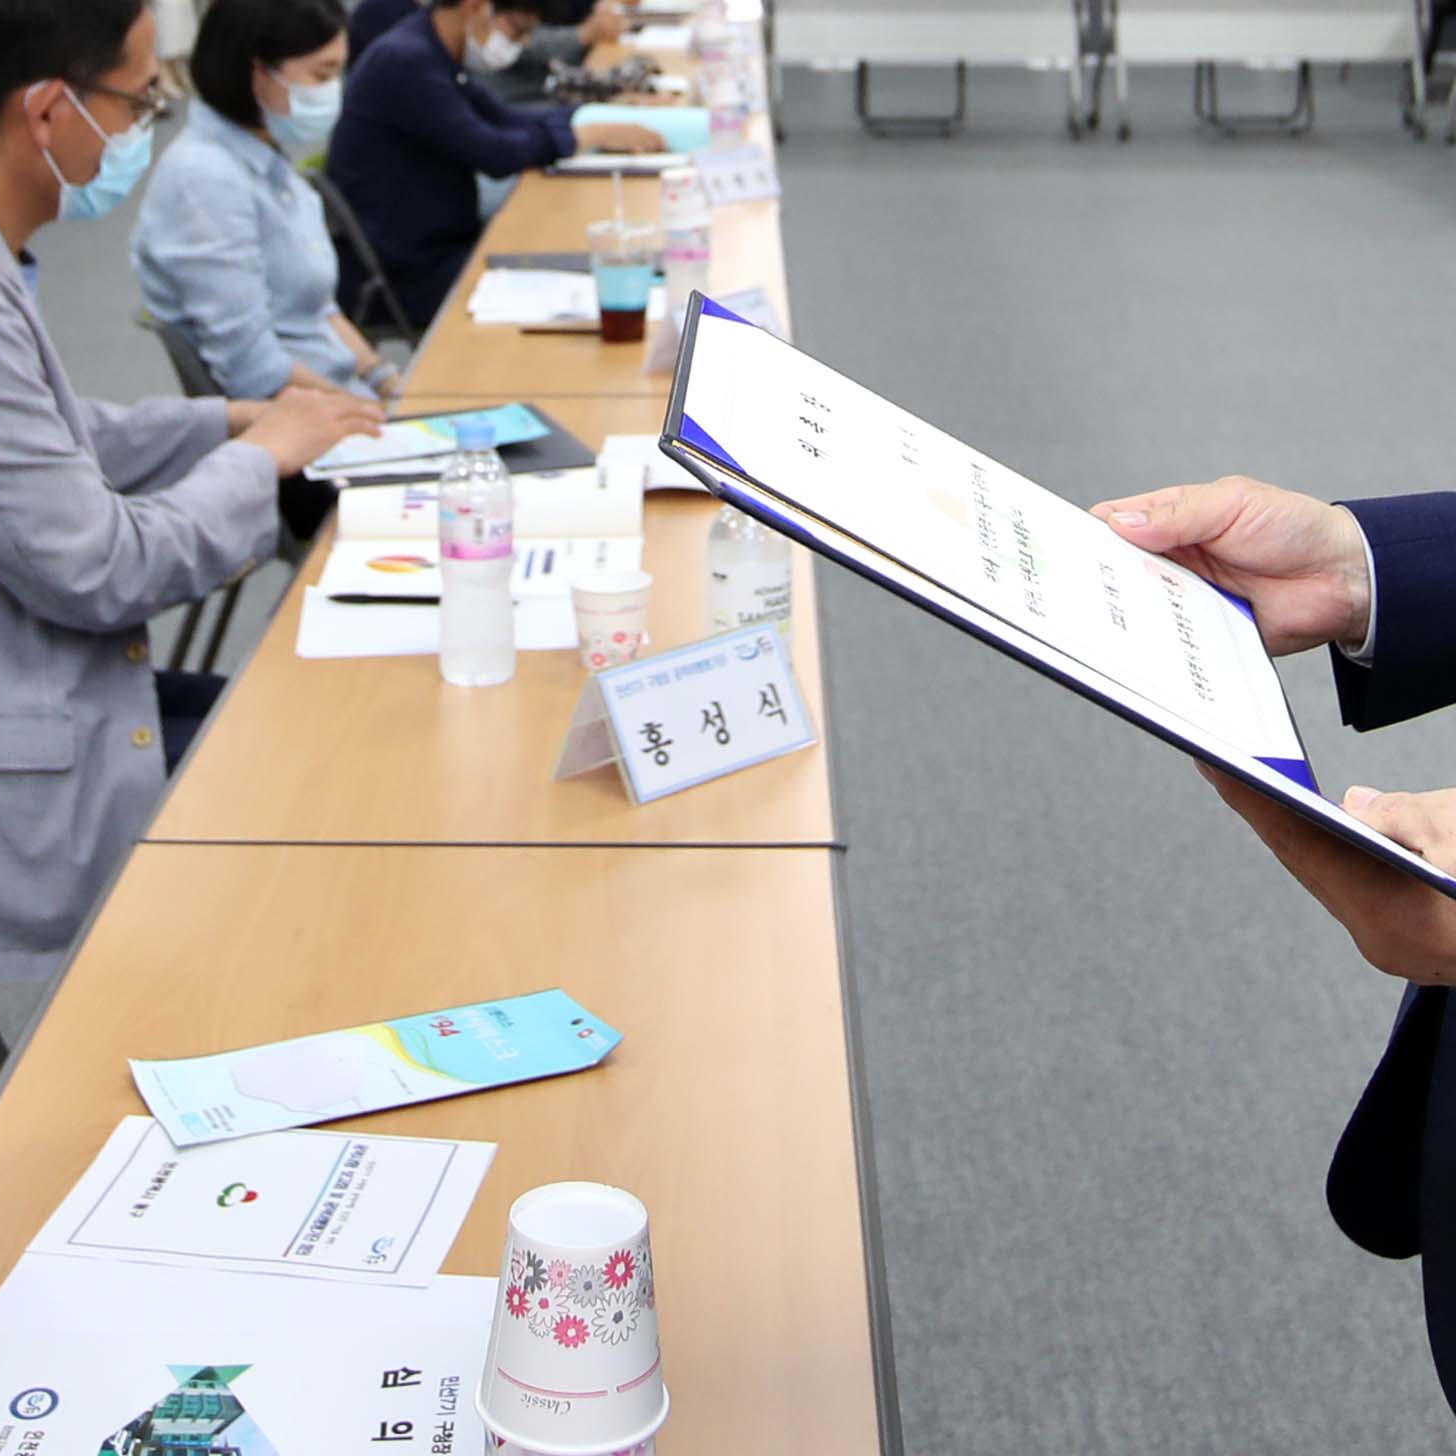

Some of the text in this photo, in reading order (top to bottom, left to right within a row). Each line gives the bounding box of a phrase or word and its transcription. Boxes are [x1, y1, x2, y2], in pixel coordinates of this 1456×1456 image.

[638, 681, 788, 766] 홍 성 식
[370, 1366, 423, 1442] 심 의
[435, 1375, 461, 1416] 민선7기
[520, 1392, 572, 1416] Classic
